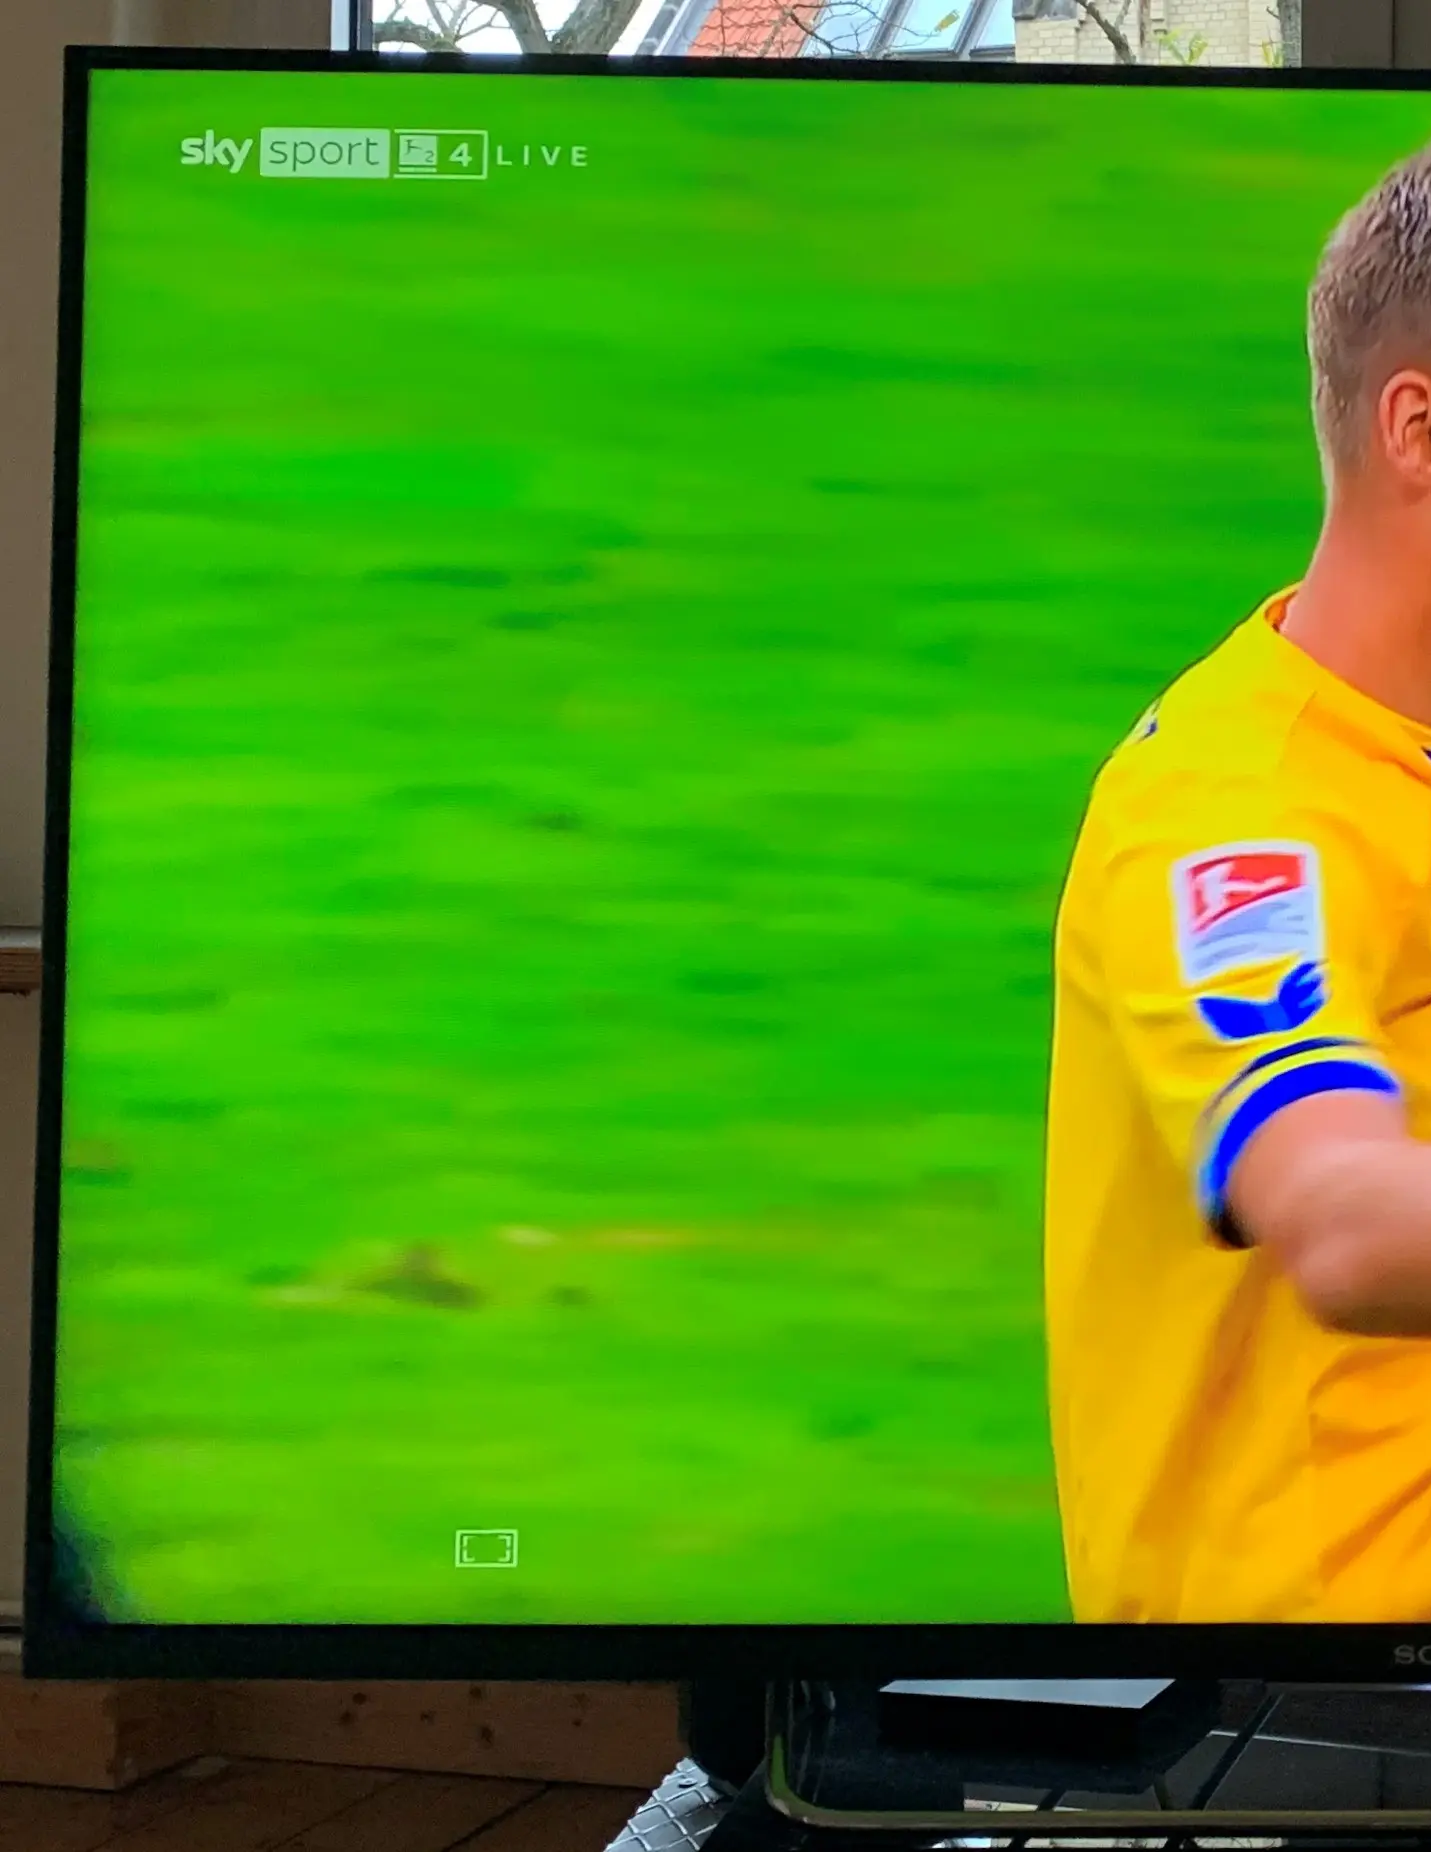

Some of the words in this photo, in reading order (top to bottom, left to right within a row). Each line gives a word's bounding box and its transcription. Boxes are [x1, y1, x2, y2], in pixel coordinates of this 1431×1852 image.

[180, 129, 253, 173] sky
[268, 136, 380, 171] sport
[447, 142, 473, 168] 4
[496, 145, 589, 168] LIVE
